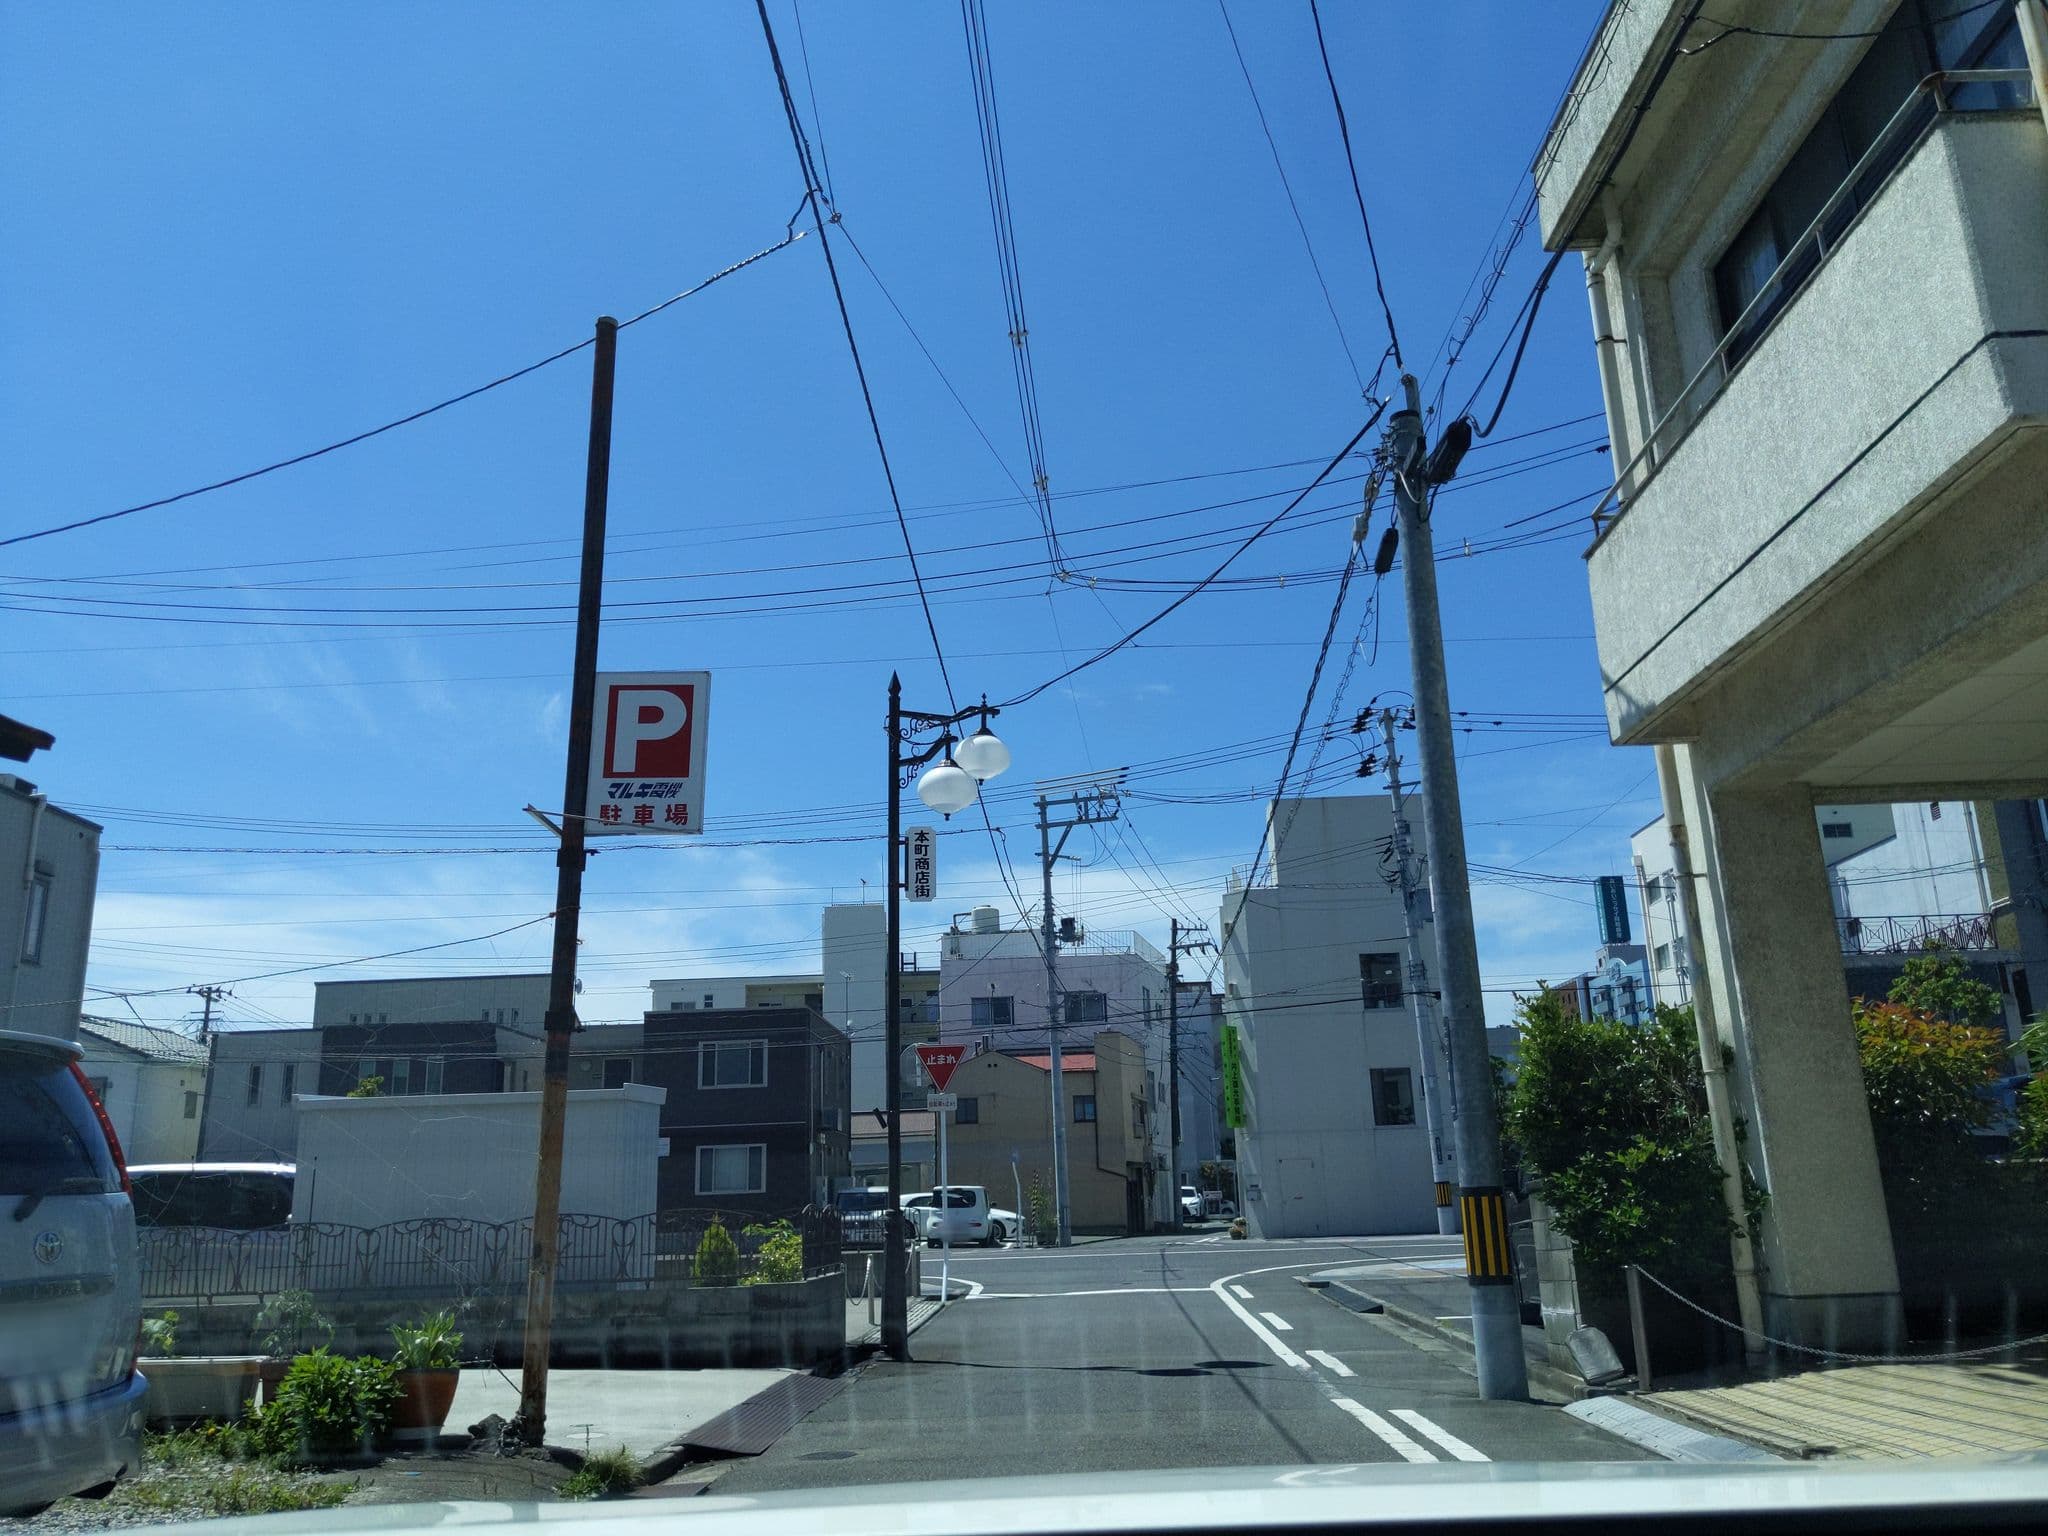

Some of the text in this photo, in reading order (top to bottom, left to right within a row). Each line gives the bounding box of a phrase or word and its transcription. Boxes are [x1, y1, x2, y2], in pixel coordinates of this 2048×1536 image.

[613, 690, 687, 773] P
[599, 803, 689, 826] 駐車場
[914, 829, 930, 898] 本町商店街
[926, 1053, 956, 1066] 止まれ
